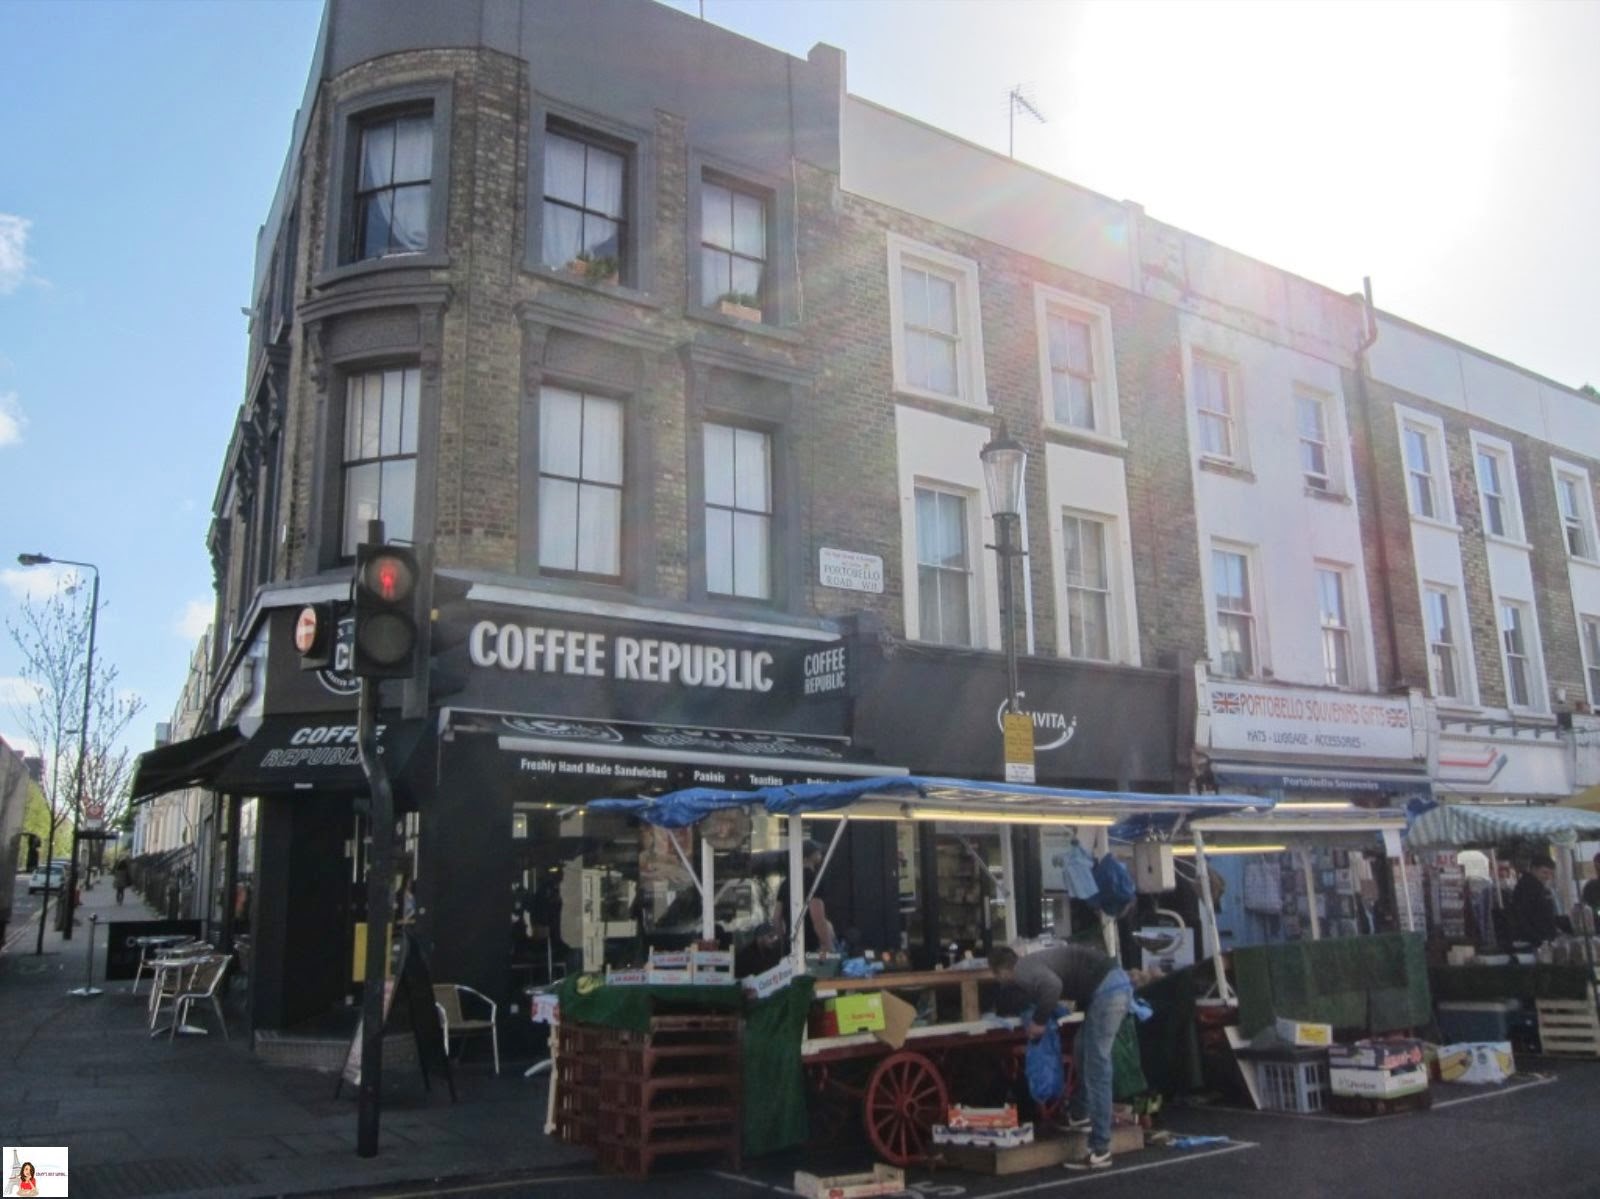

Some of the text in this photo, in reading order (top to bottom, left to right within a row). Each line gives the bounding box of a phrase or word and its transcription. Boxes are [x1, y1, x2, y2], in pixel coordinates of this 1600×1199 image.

[824, 564, 881, 581] PORTOBELLO
[826, 575, 851, 587] ROAD
[469, 620, 774, 693] COFFEE REPUBLIC
[804, 647, 846, 677] COFFEE
[804, 670, 846, 695] REPUBLIC
[1240, 692, 1304, 721] PORTOBELLO
[1247, 730, 1362, 749] HATS LUGGAGE ACCESSORIES
[520, 757, 556, 774] Freshly
[558, 760, 584, 774] Hand
[585, 763, 613, 776] Made
[613, 764, 669, 780] Sandwiches
[749, 773, 784, 787] Toasties
